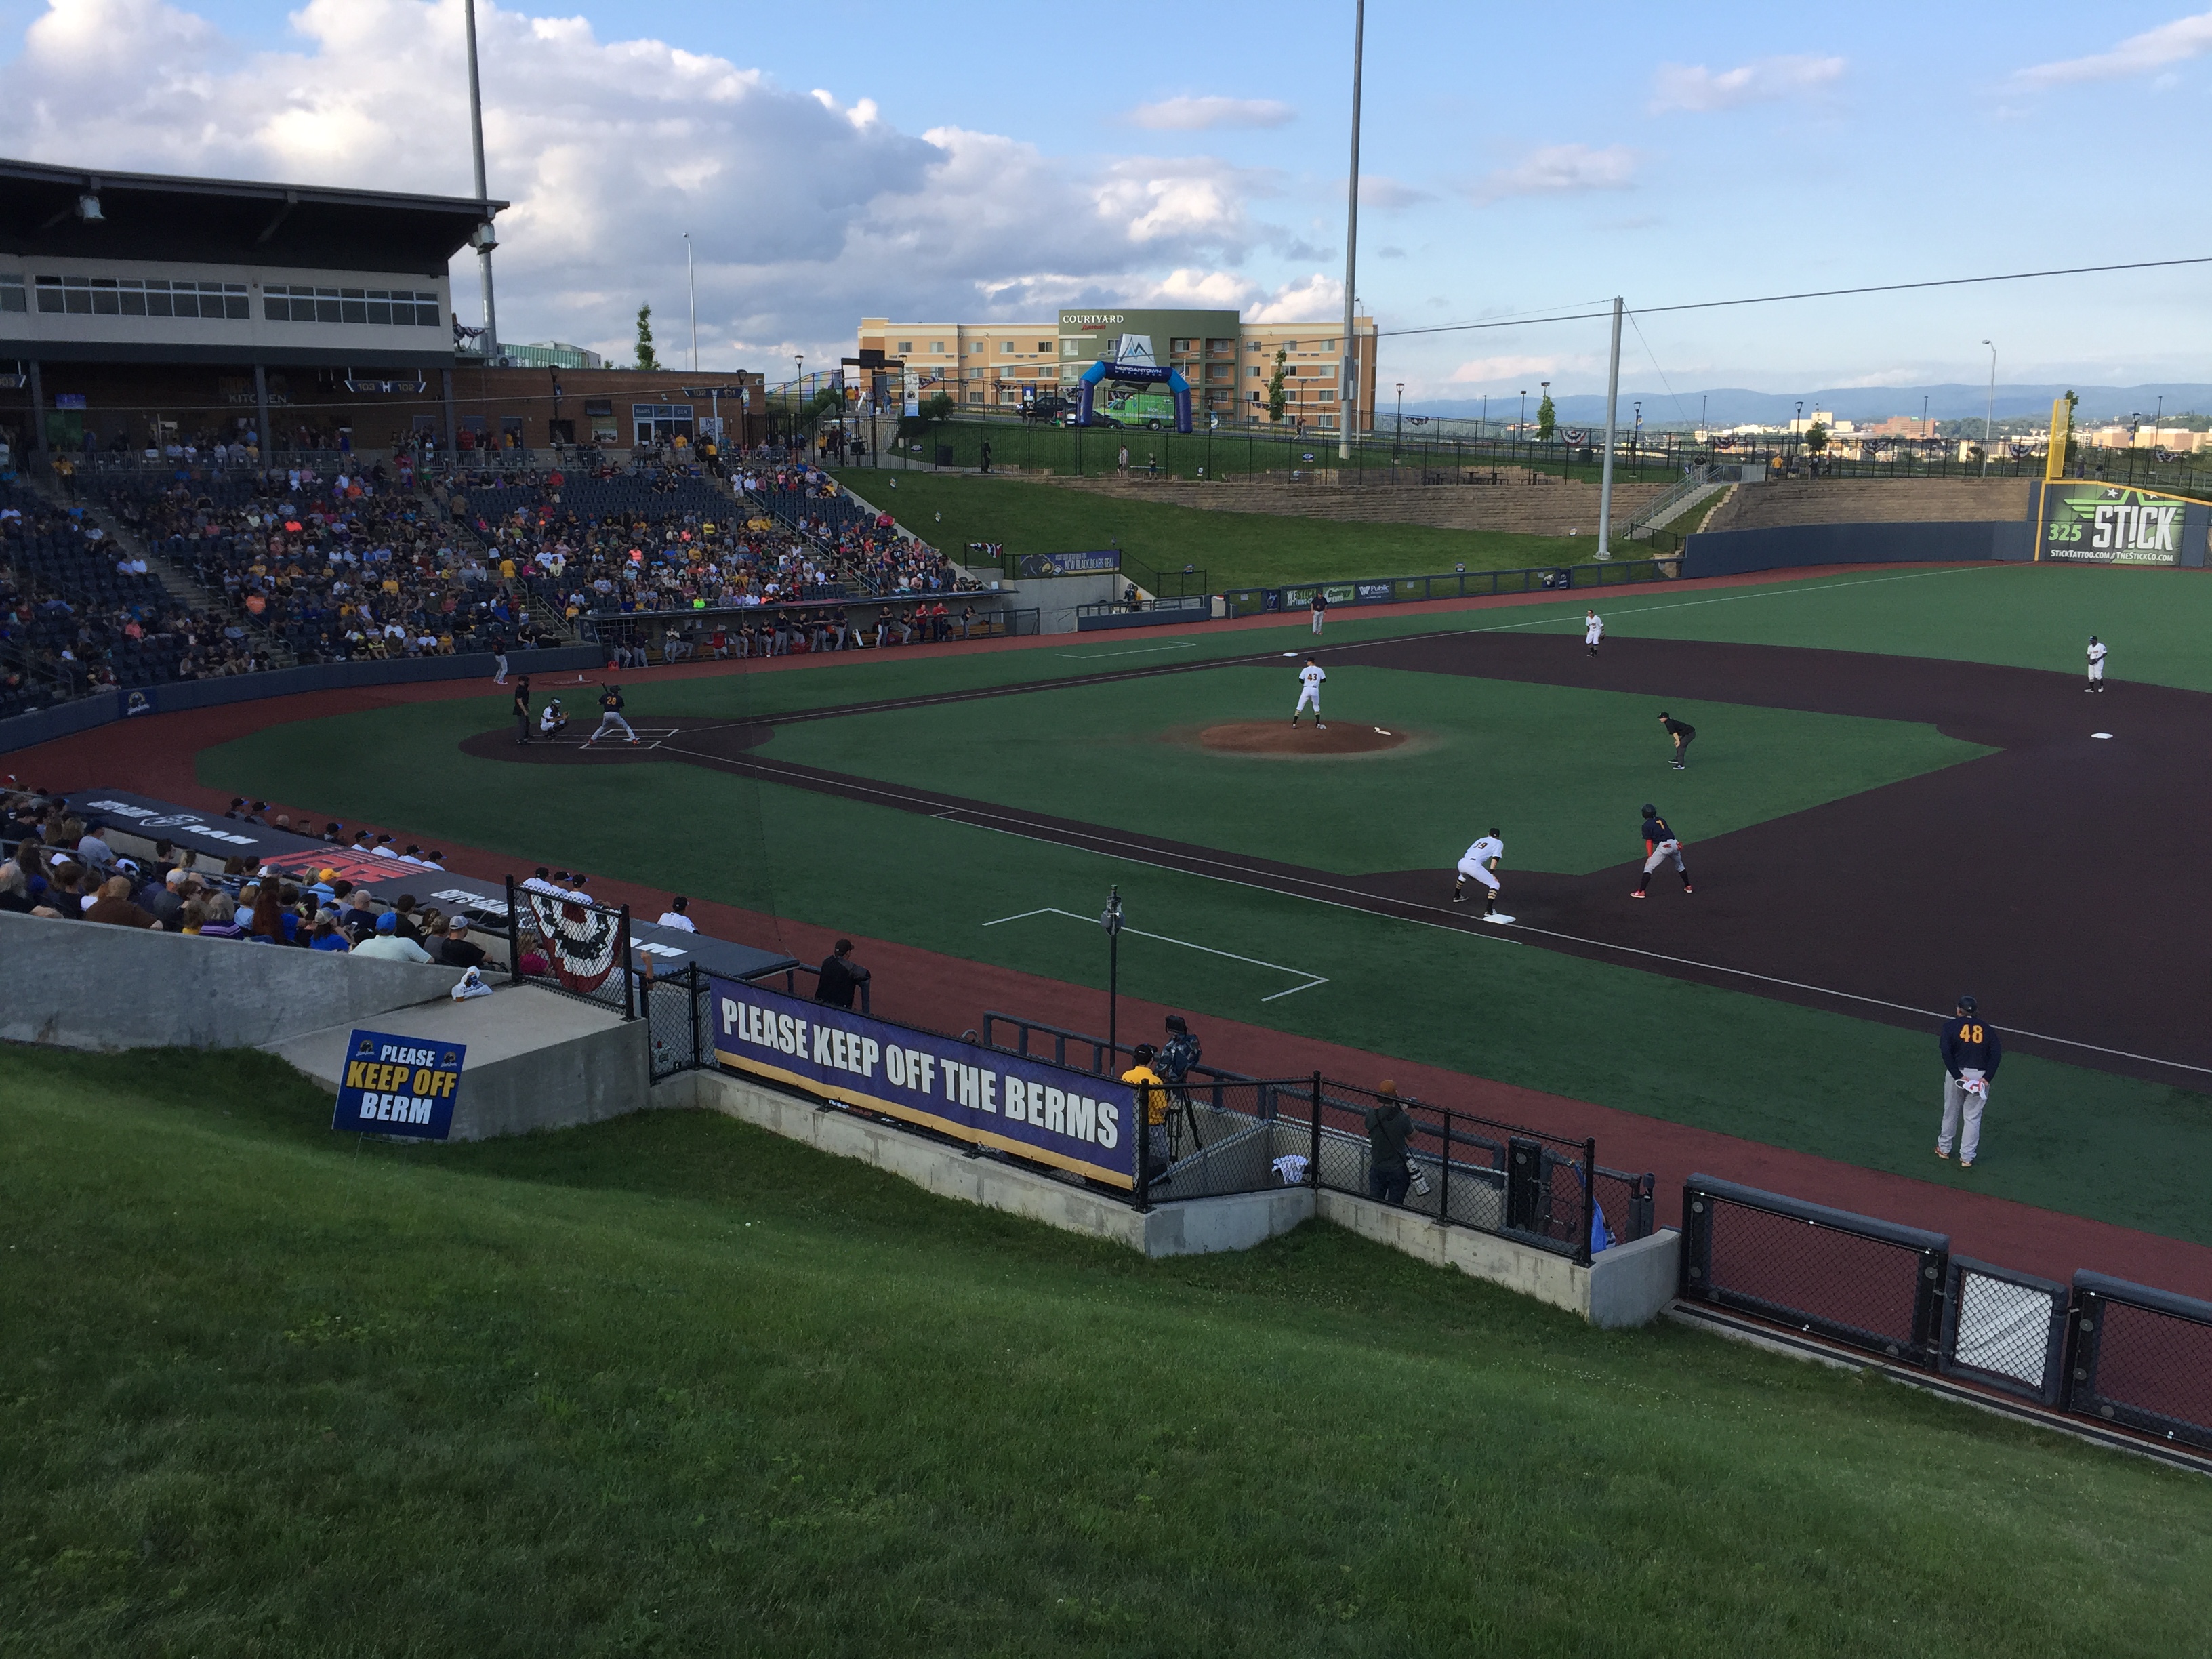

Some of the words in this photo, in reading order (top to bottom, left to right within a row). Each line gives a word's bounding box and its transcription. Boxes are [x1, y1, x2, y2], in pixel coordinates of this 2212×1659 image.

[1063, 315, 1124, 323] COURTYARD
[358, 383, 375, 391] 103
[398, 384, 415, 392] 102
[2048, 523, 2083, 541] 325
[2093, 506, 2177, 550] STICK
[1307, 673, 1317, 682] 43
[607, 696, 617, 705] 28
[1656, 819, 1665, 830] 7
[1959, 1024, 1983, 1044] 48
[380, 1044, 436, 1067] PLEASE
[346, 1061, 409, 1092] KEEP
[413, 1069, 457, 1098] OFF
[722, 997, 809, 1060] PLEASE
[813, 1024, 879, 1078] KEEP
[886, 1044, 935, 1094] OFF
[940, 1058, 997, 1114] THE
[1004, 1075, 1119, 1149] BERMS
[359, 1092, 433, 1125] BERM
